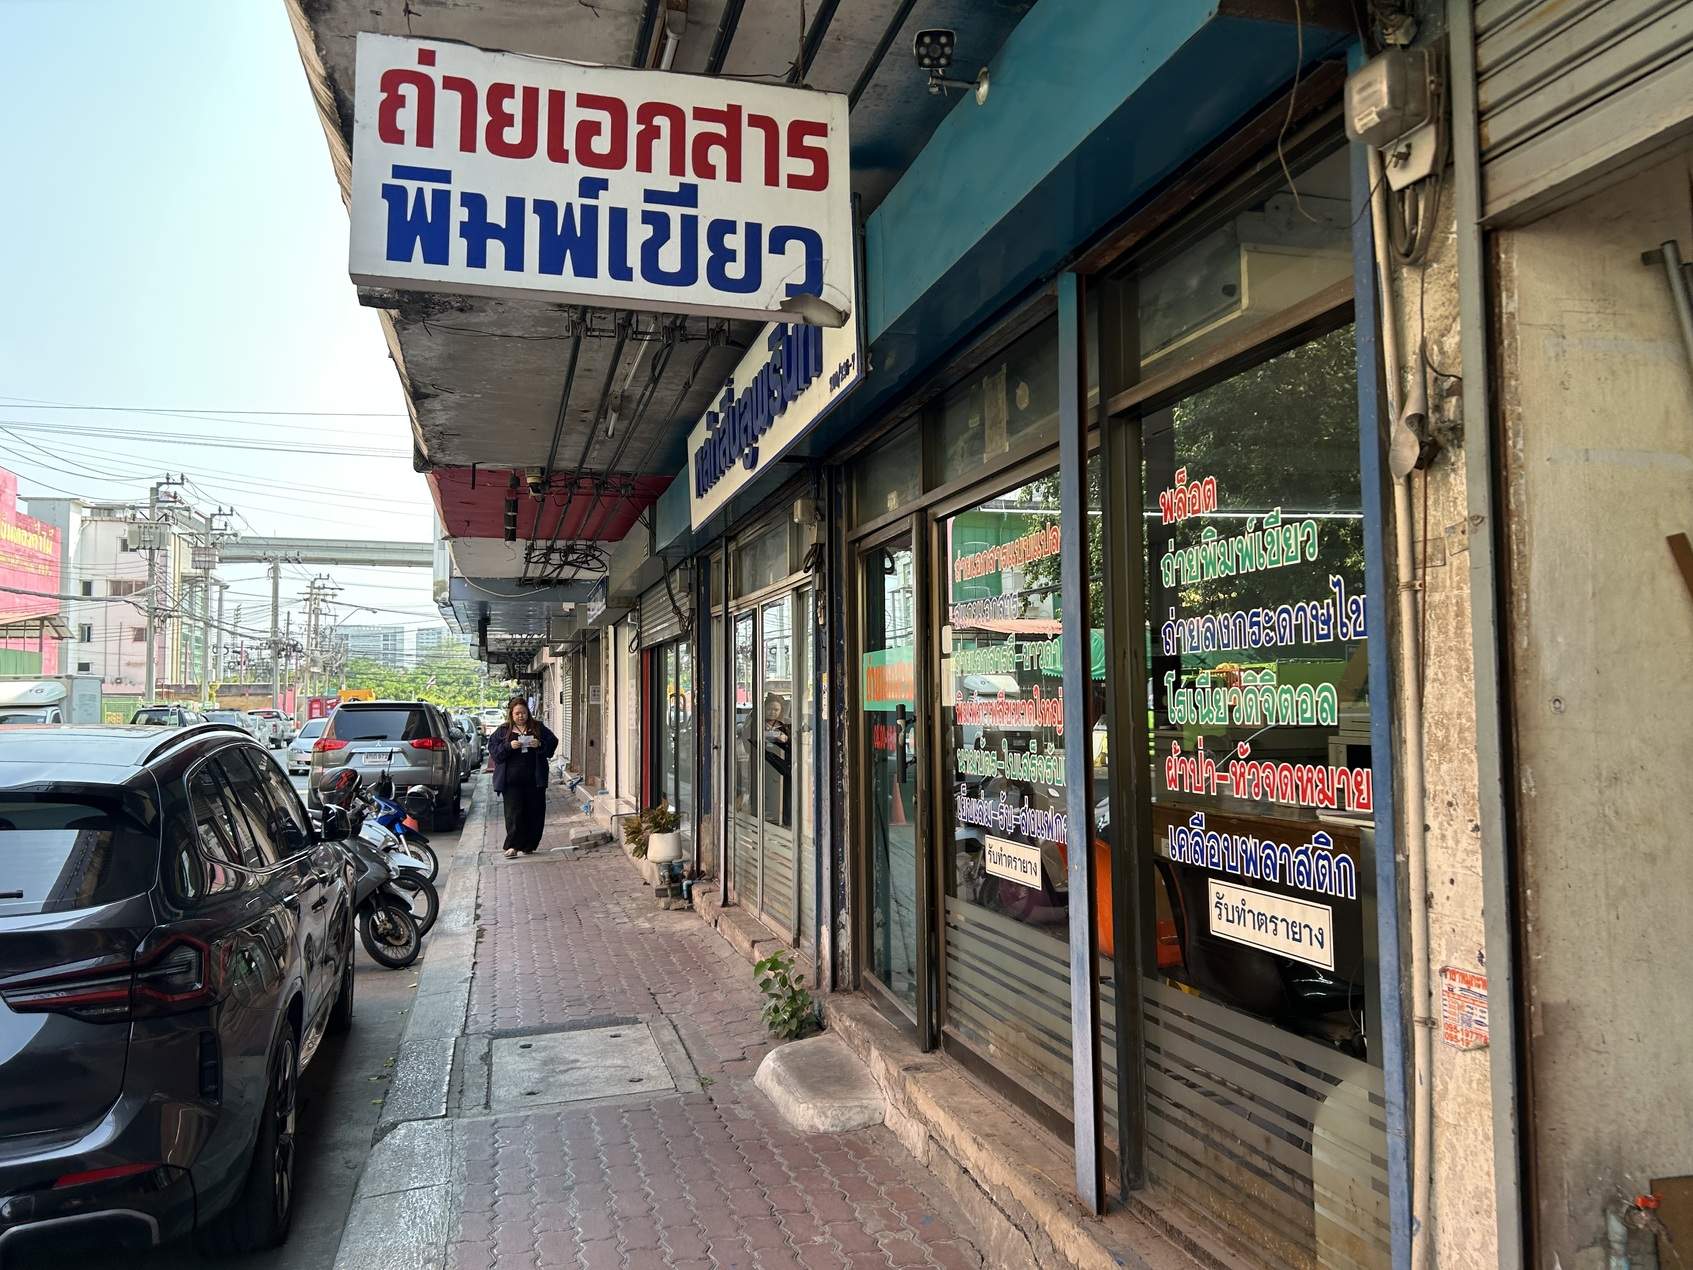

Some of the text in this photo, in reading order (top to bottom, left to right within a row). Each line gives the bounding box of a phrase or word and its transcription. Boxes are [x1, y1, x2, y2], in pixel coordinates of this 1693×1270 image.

[378, 48, 830, 192] ถ่ายเอกสาร
[381, 164, 824, 299] พิมพ์เขียว
[1159, 466, 1218, 525] พล็อต
[1160, 507, 1319, 588] ถ่ายพิมพ์เขียว
[1161, 574, 1369, 656] ถ่ายลงกระดาษไข
[1163, 668, 1339, 726] โรเนียวดิจิตอล
[1165, 736, 1373, 812] ผ้าป่า-หัวจดหมาย
[987, 845, 1038, 876] รับทำตรายาง
[1168, 811, 1357, 901] เคลือบพลาสติก
[1214, 893, 1325, 950] รับทำตรายาง
